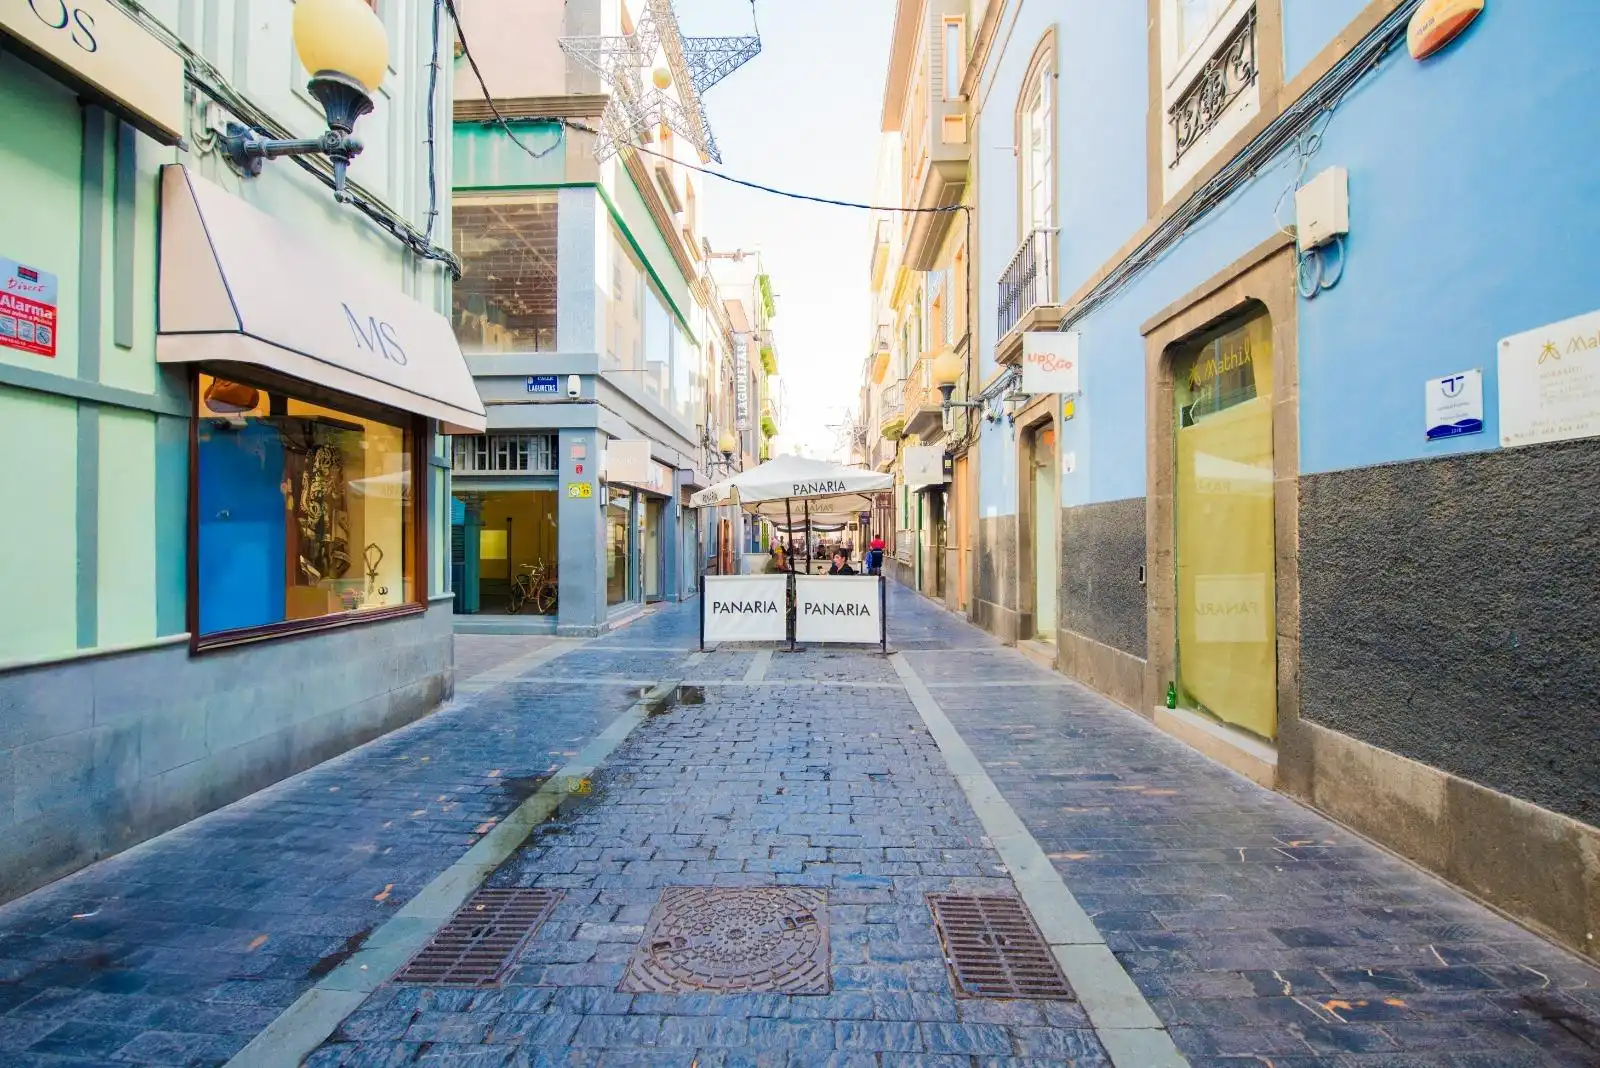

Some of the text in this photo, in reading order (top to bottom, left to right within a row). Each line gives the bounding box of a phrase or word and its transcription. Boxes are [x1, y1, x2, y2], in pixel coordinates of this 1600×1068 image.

[0, 294, 53, 319] Alarma
[340, 301, 408, 366] MS
[793, 481, 846, 495] PANARIA
[713, 601, 778, 614] PANARIA
[804, 602, 871, 617] PANARIA
